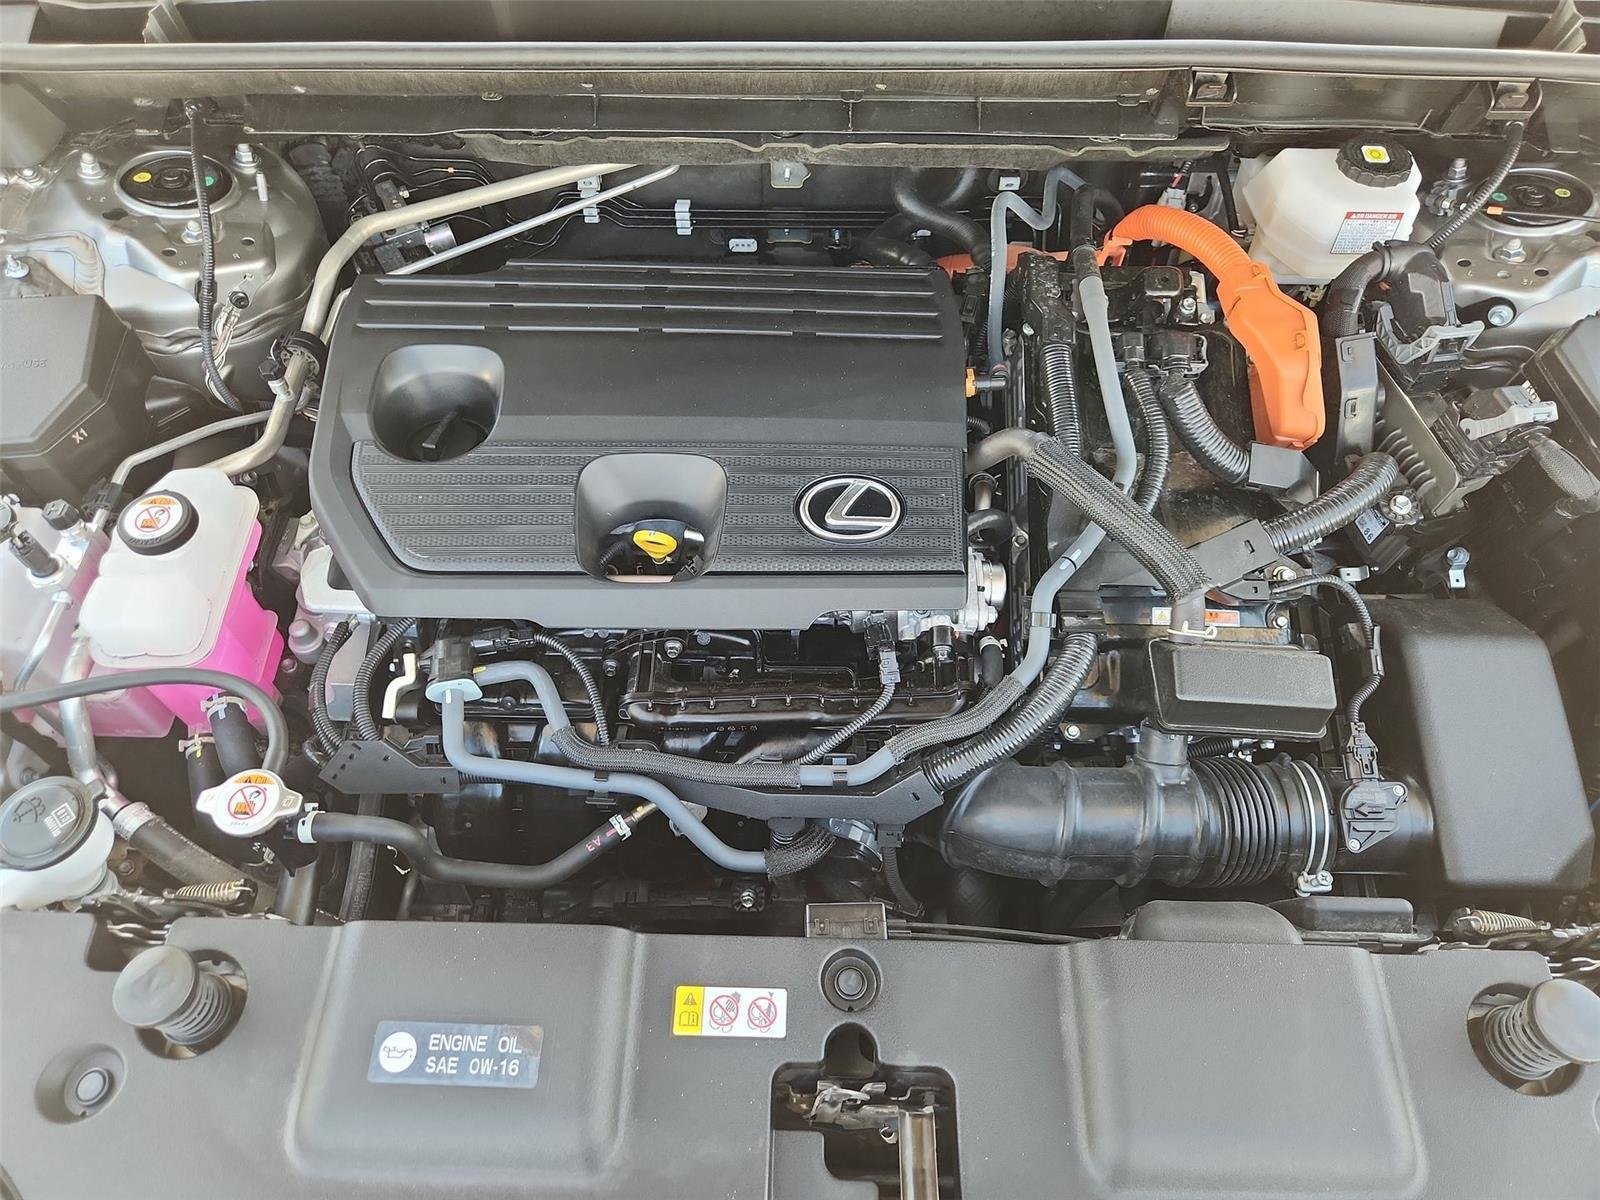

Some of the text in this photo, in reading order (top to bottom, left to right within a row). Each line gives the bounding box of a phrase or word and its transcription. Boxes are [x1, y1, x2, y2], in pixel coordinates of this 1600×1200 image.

[71, 427, 88, 444] X1
[428, 1033, 522, 1054] ENGINE OIL
[425, 1056, 520, 1076] SAE 0W-16
